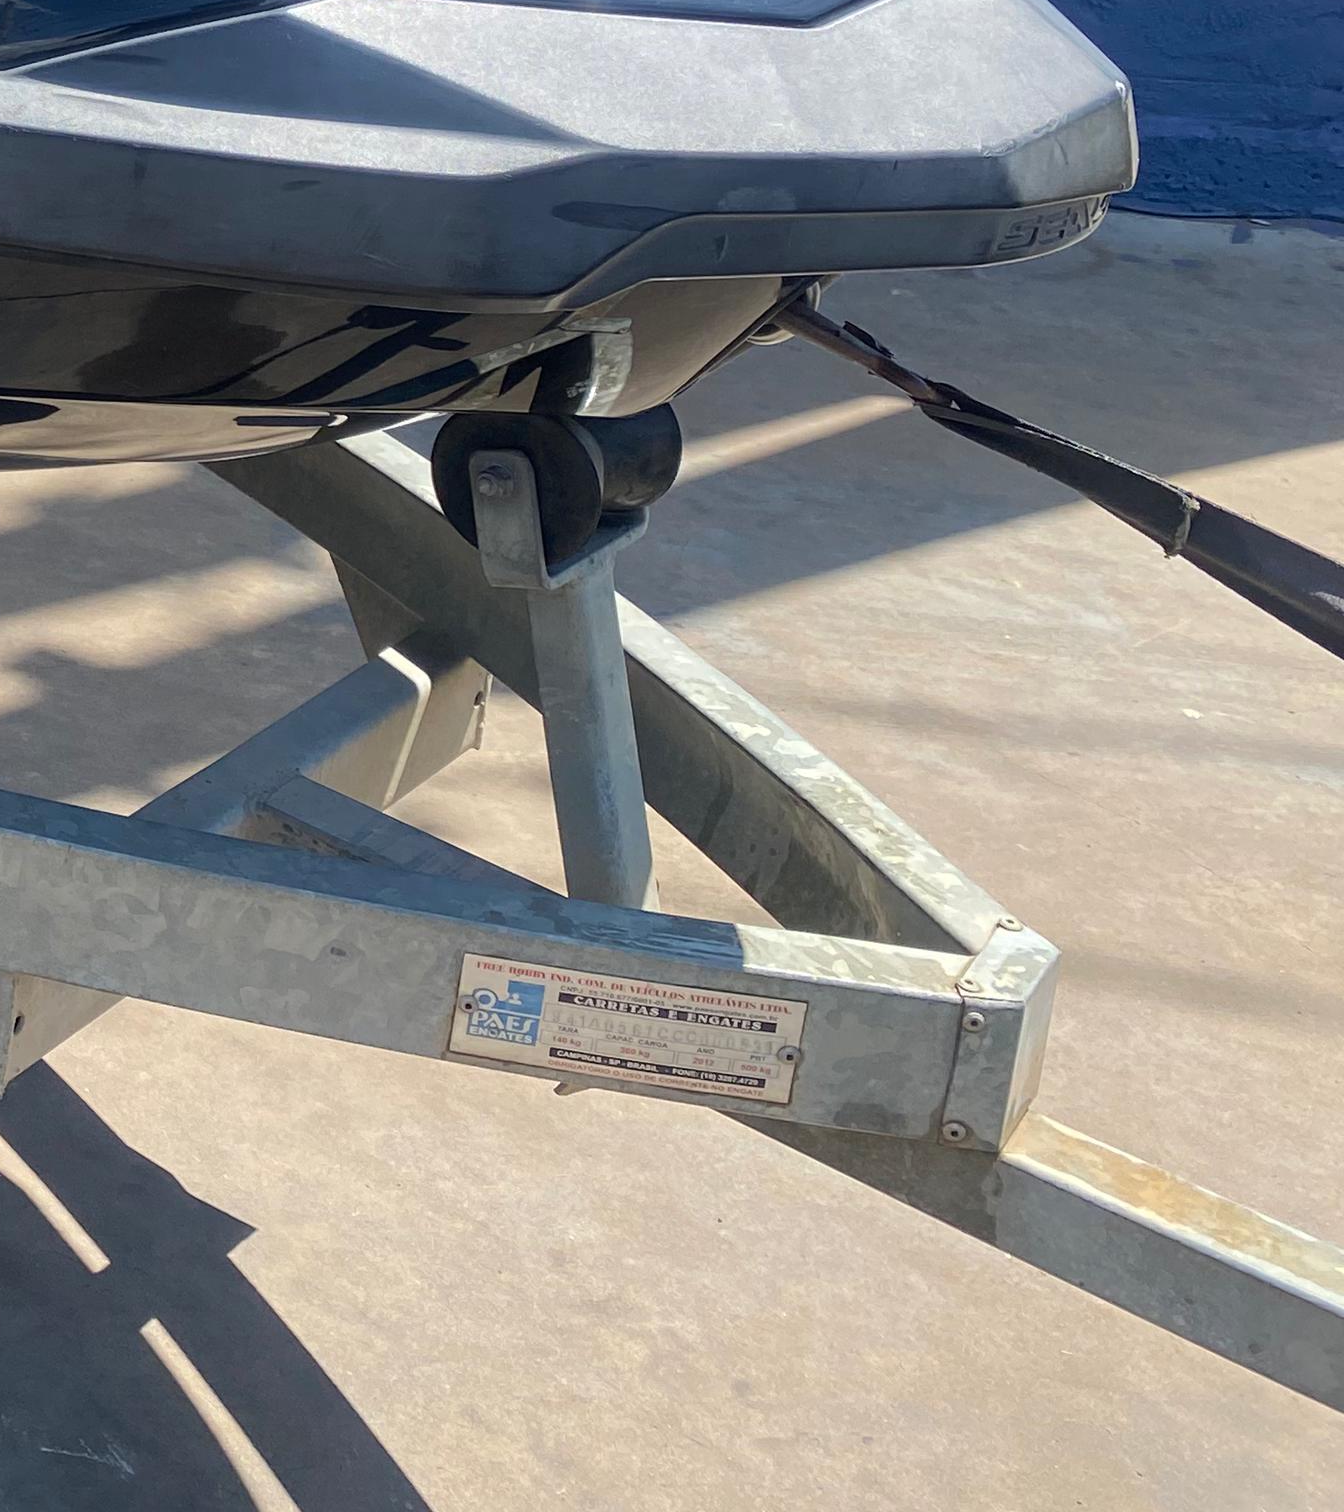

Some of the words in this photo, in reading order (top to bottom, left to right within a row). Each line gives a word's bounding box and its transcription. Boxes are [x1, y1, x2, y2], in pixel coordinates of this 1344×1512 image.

[470, 1008, 534, 1034] PAES
[572, 995, 660, 1017] CARRETAS
[667, 1009, 678, 1019] E
[686, 1011, 762, 1031] ENGATES
[468, 1024, 532, 1044] ENGATES
[556, 1049, 602, 1063] CAMPINAS
[625, 1060, 659, 1072] BRASIL
[696, 1046, 715, 1055] ANO
